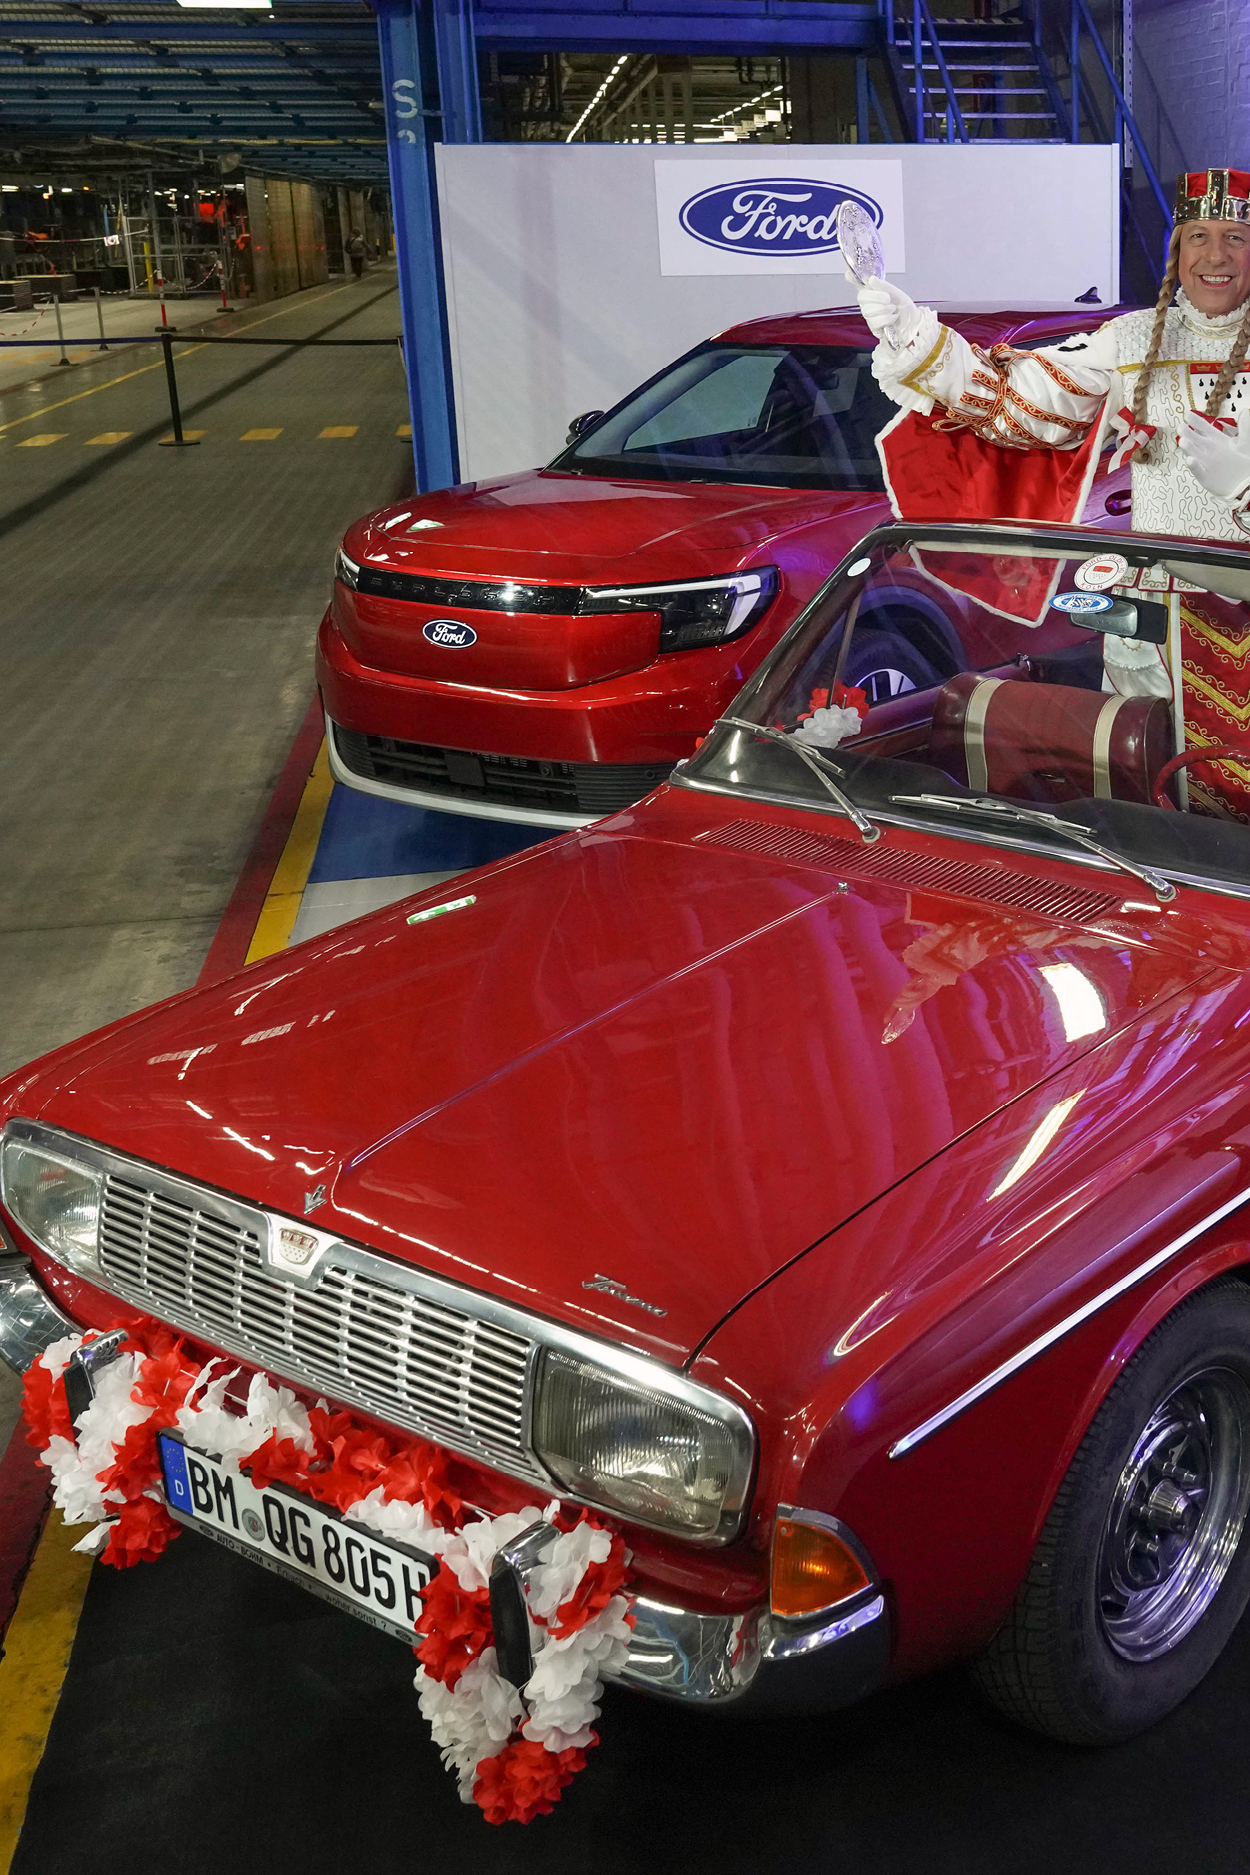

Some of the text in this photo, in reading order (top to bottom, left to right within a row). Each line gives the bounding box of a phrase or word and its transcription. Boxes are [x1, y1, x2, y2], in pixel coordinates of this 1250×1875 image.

[720, 190, 839, 240] Ford
[432, 623, 465, 645] Ford
[175, 1479, 184, 1496] D
[187, 1456, 240, 1530] BM
[262, 1494, 316, 1569] QG
